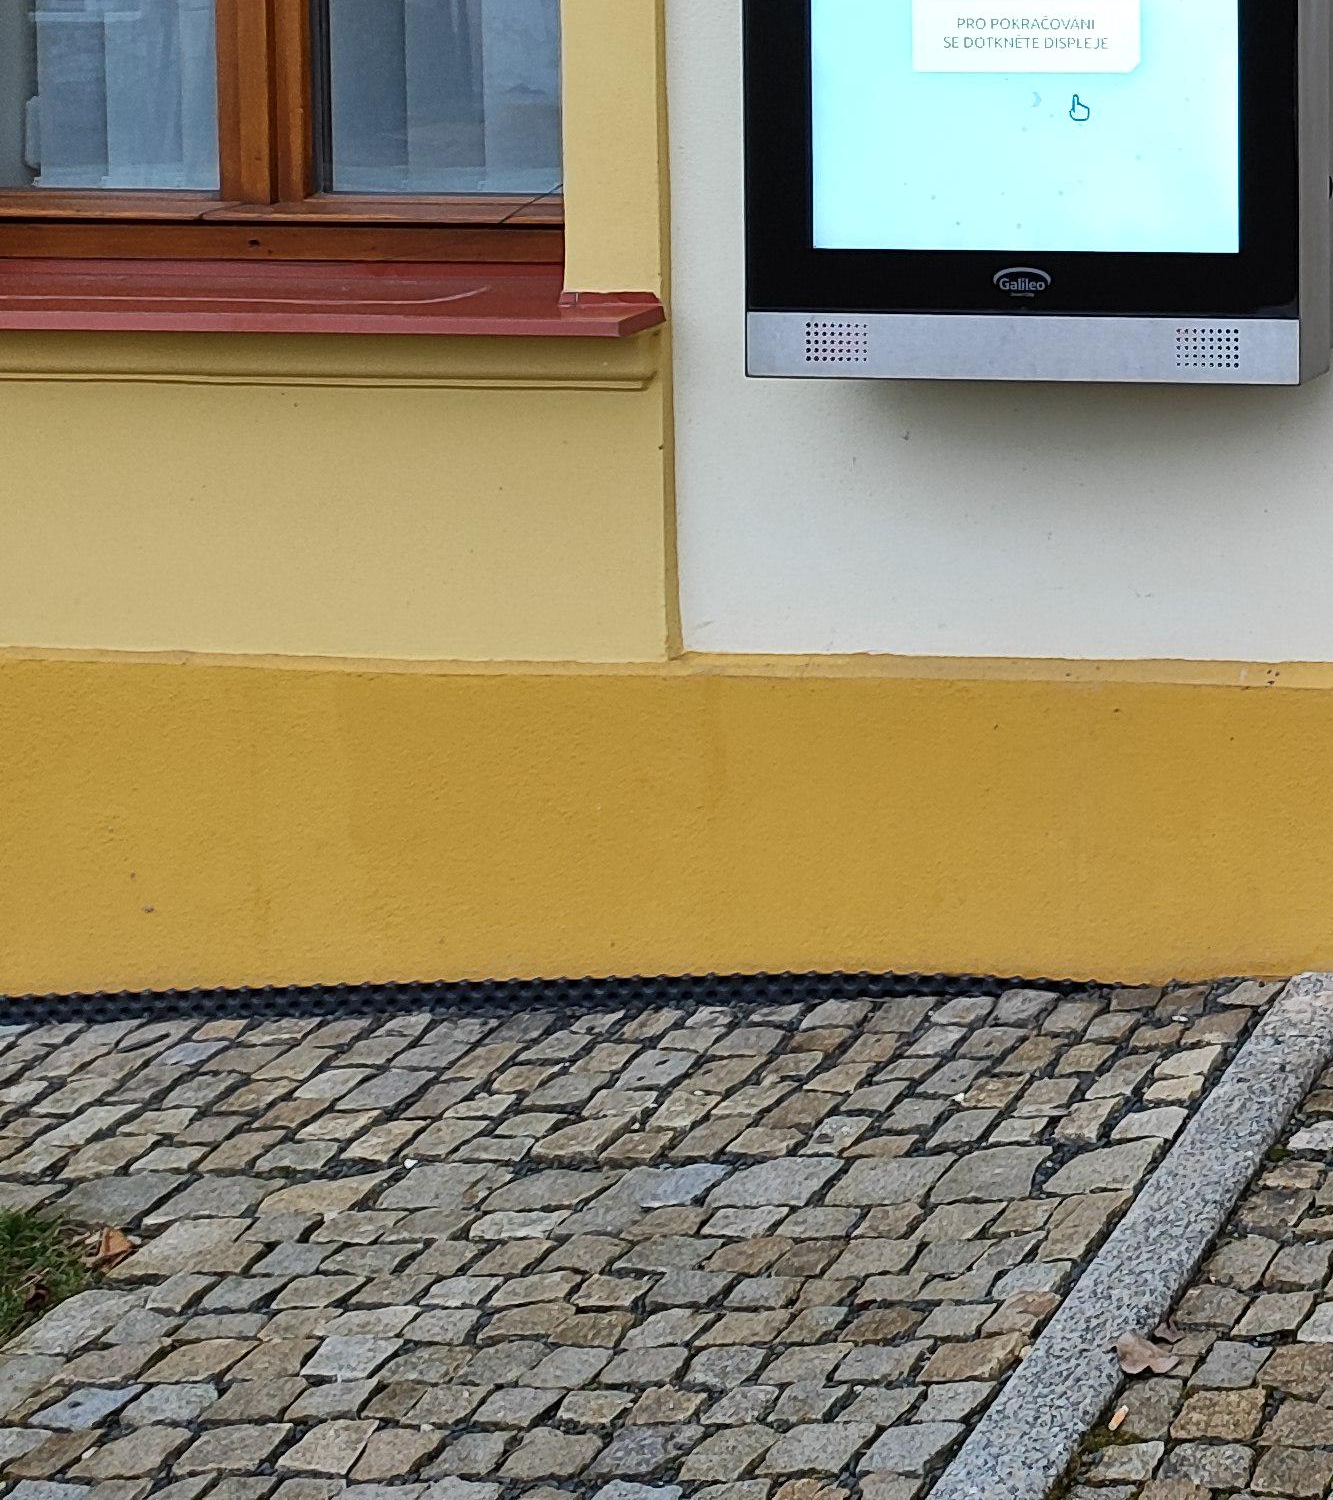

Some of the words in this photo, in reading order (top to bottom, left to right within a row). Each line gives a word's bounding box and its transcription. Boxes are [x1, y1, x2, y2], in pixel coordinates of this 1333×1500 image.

[957, 17, 986, 30] PRO
[943, 36, 959, 49] SE
[1044, 36, 1110, 50] DISPLEJE
[998, 277, 1046, 291] Galileo
